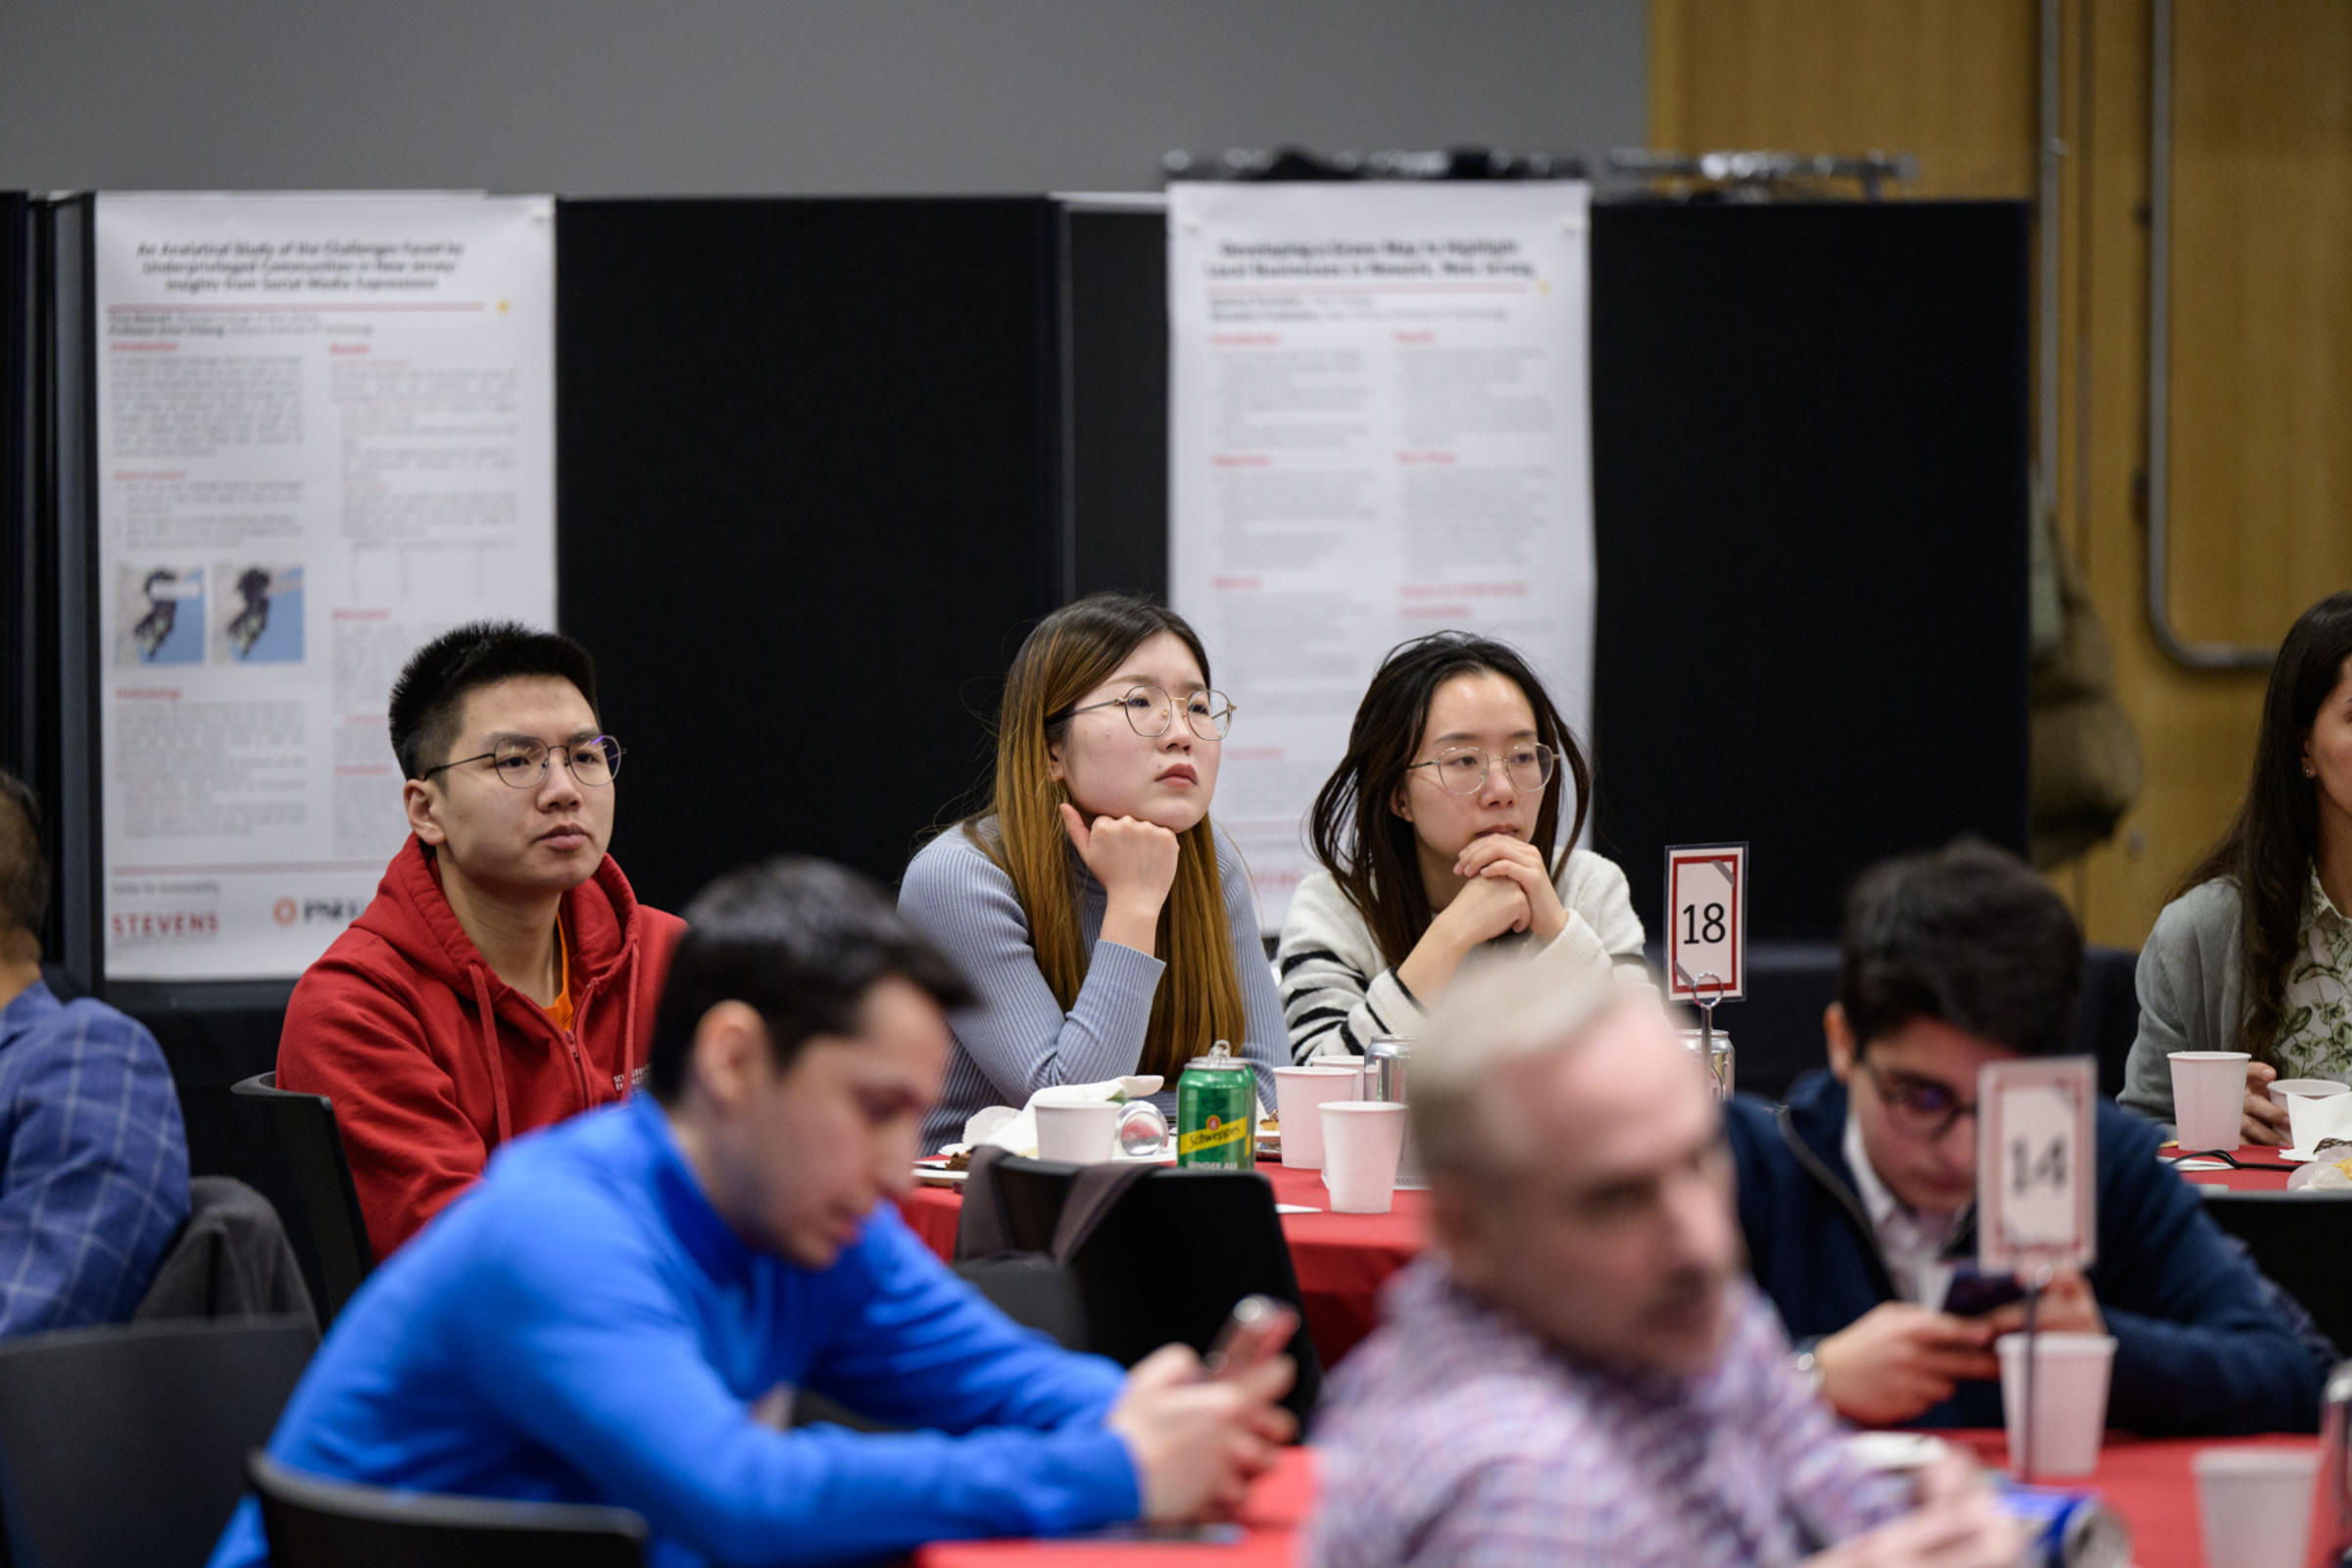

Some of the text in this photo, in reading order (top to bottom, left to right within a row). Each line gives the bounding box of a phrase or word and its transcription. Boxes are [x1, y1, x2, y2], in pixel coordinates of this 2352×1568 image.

[112, 912, 219, 937] STEVENS
[1683, 903, 1726, 944] 18
[1188, 1126, 1240, 1150] Schweppes
[2012, 1135, 2068, 1195] 14
